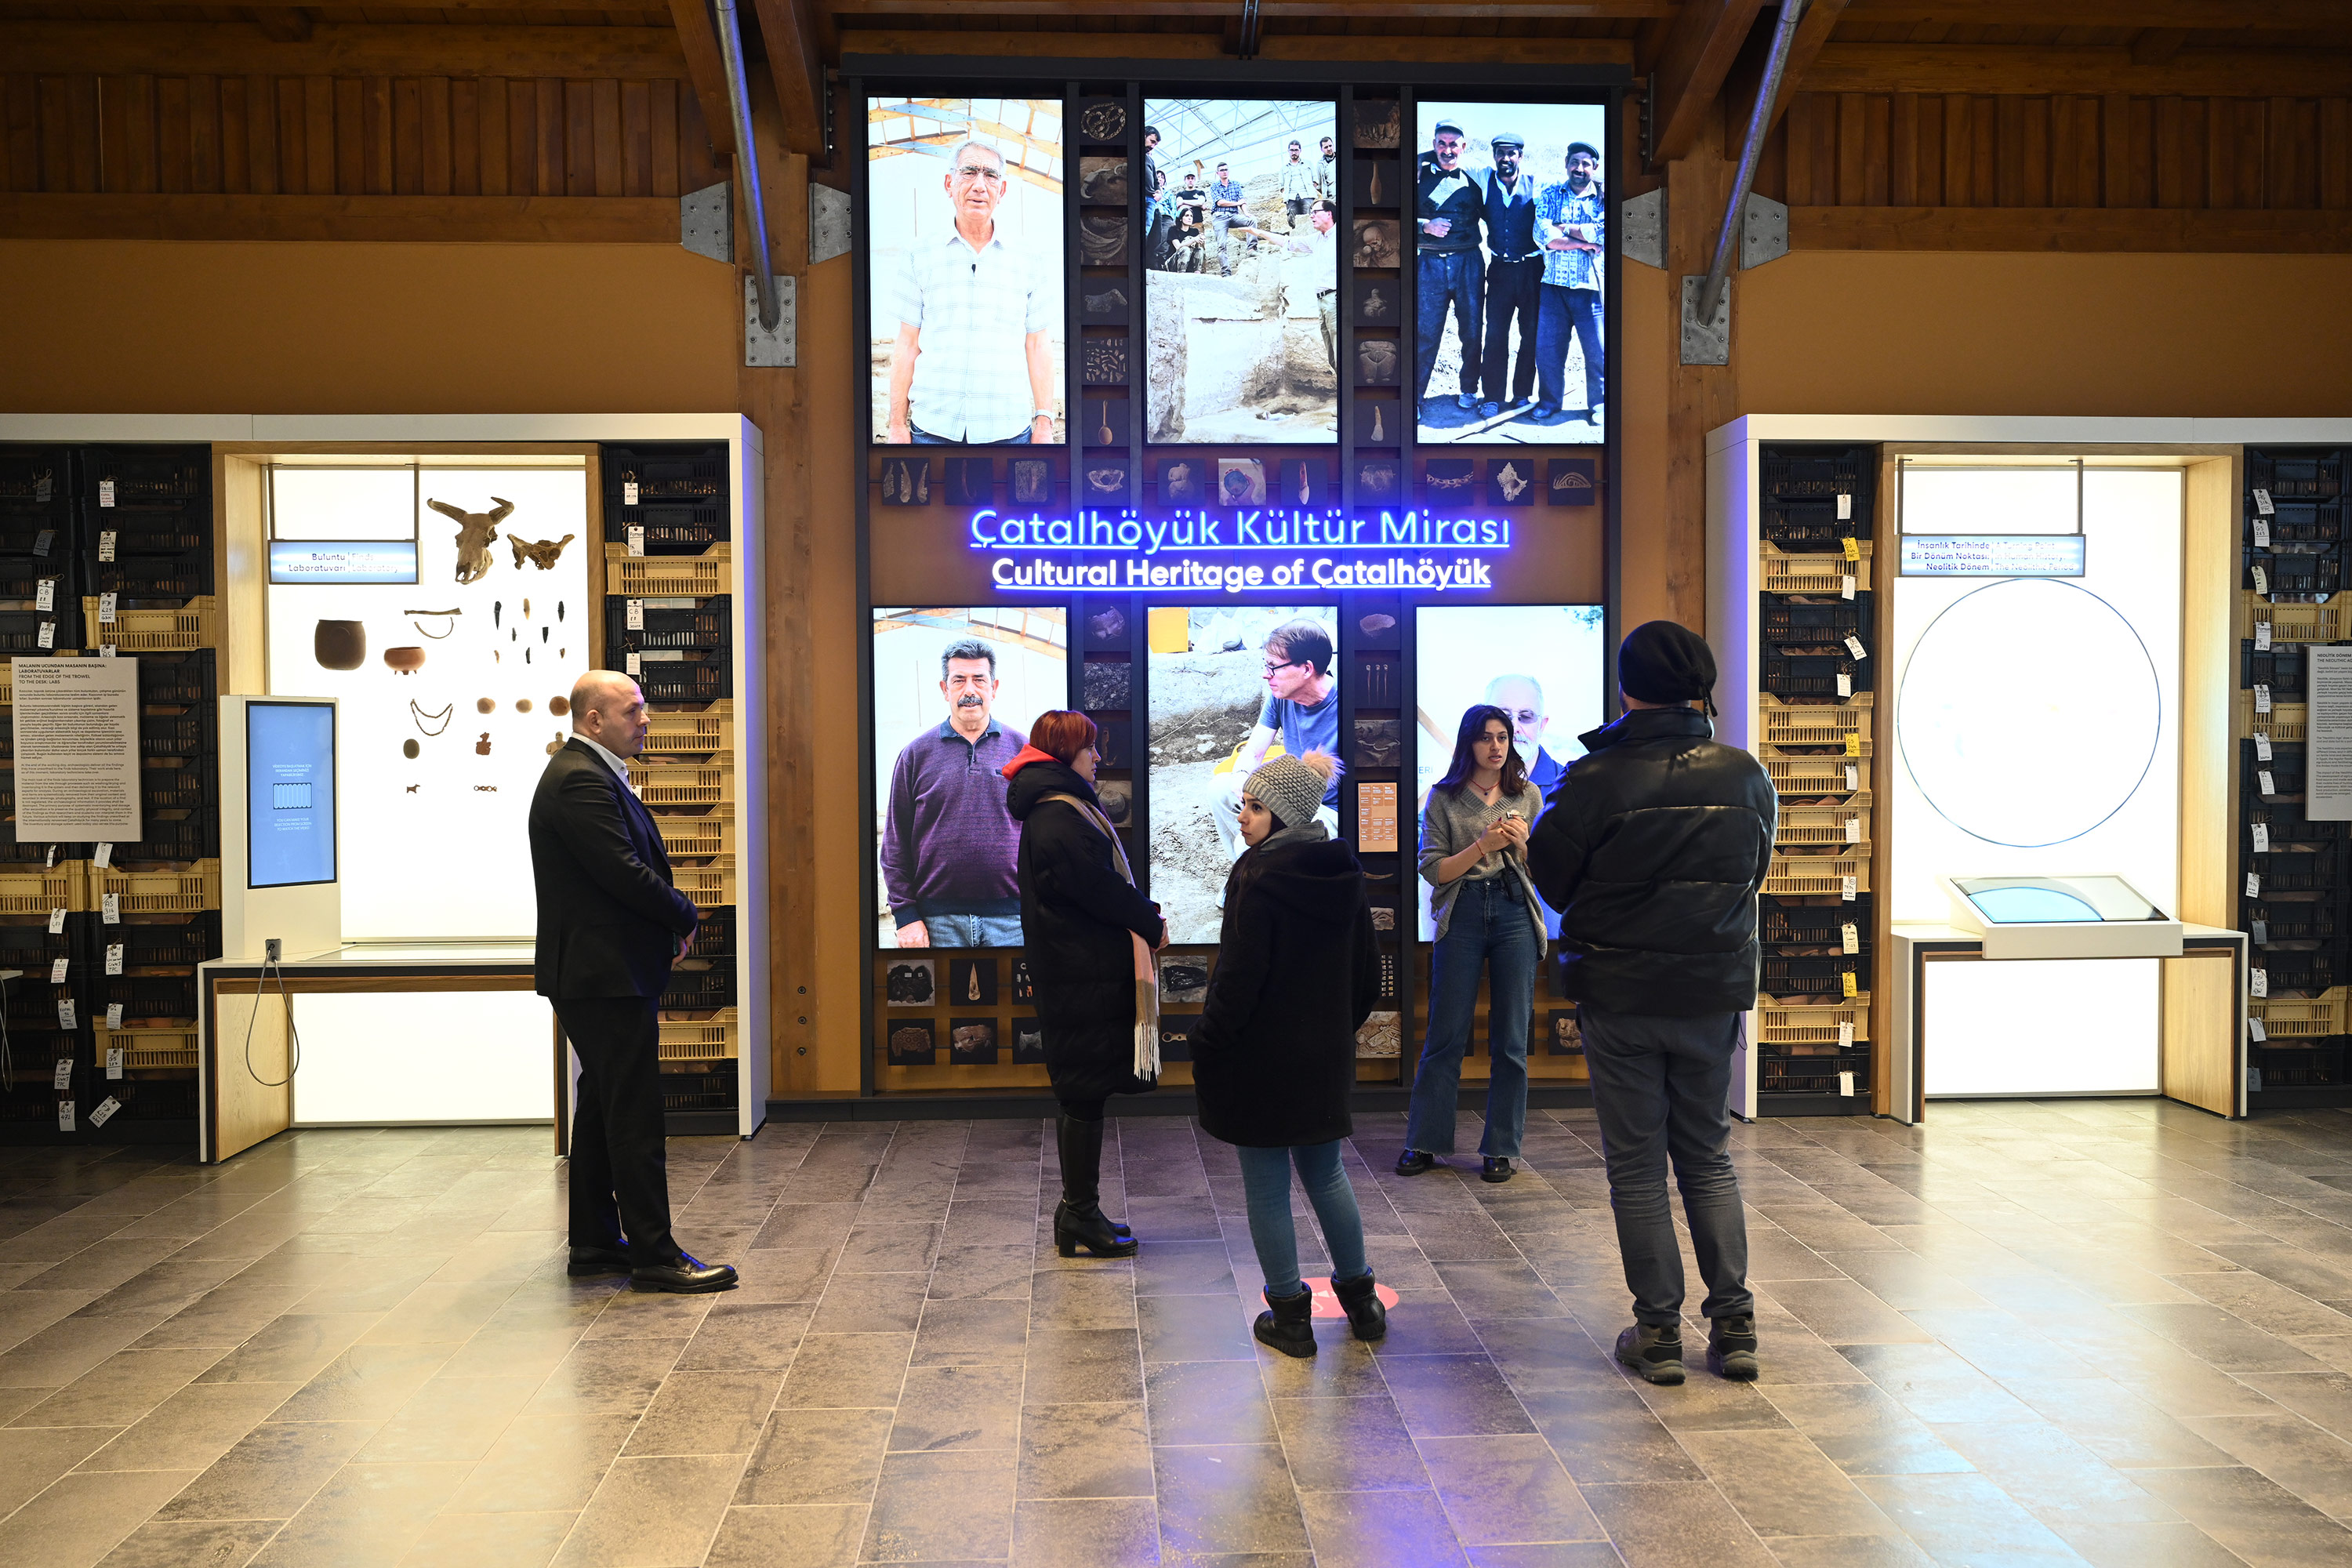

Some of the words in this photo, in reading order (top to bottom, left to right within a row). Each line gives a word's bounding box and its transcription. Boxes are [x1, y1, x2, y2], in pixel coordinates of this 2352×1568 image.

[971, 510, 1219, 555] Çatalhöyük
[1236, 509, 1366, 544] Kültür
[1381, 509, 1510, 544] Mirası
[1918, 539, 1950, 549] İnsanlık
[992, 557, 1116, 586] Cultural
[1127, 558, 1265, 593] Heritage
[1272, 558, 1305, 586] of
[1312, 557, 1491, 591] Çatalhöyük
